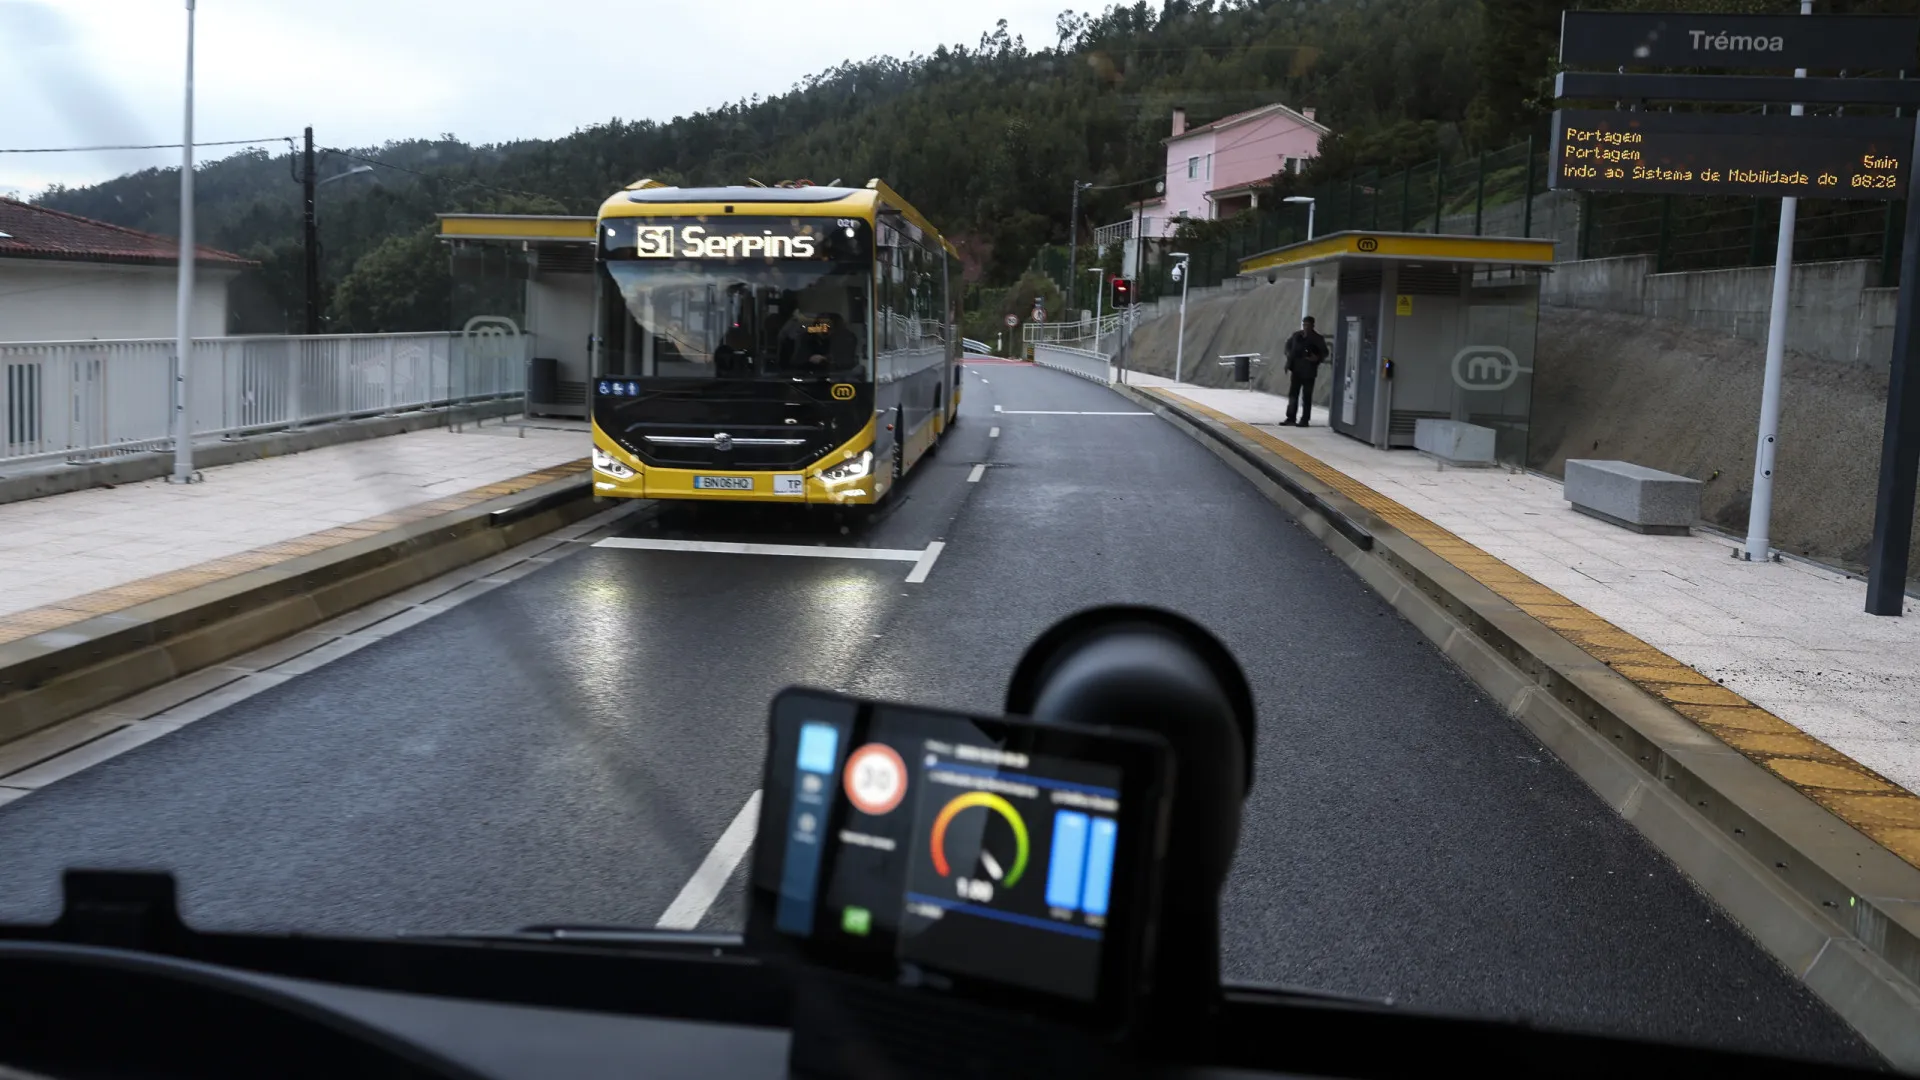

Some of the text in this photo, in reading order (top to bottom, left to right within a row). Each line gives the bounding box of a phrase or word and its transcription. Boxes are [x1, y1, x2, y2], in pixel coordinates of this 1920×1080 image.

[1688, 30, 1784, 51] Trémoa
[1567, 127, 1643, 145] Portagem
[1565, 145, 1899, 169] Portagem 5min
[1563, 164, 1838, 186] indo ao Sistema de Mobilidade do
[1851, 174, 1897, 188] 08:28
[640, 226, 815, 257] S1 Serpins
[787, 479, 802, 489] TP
